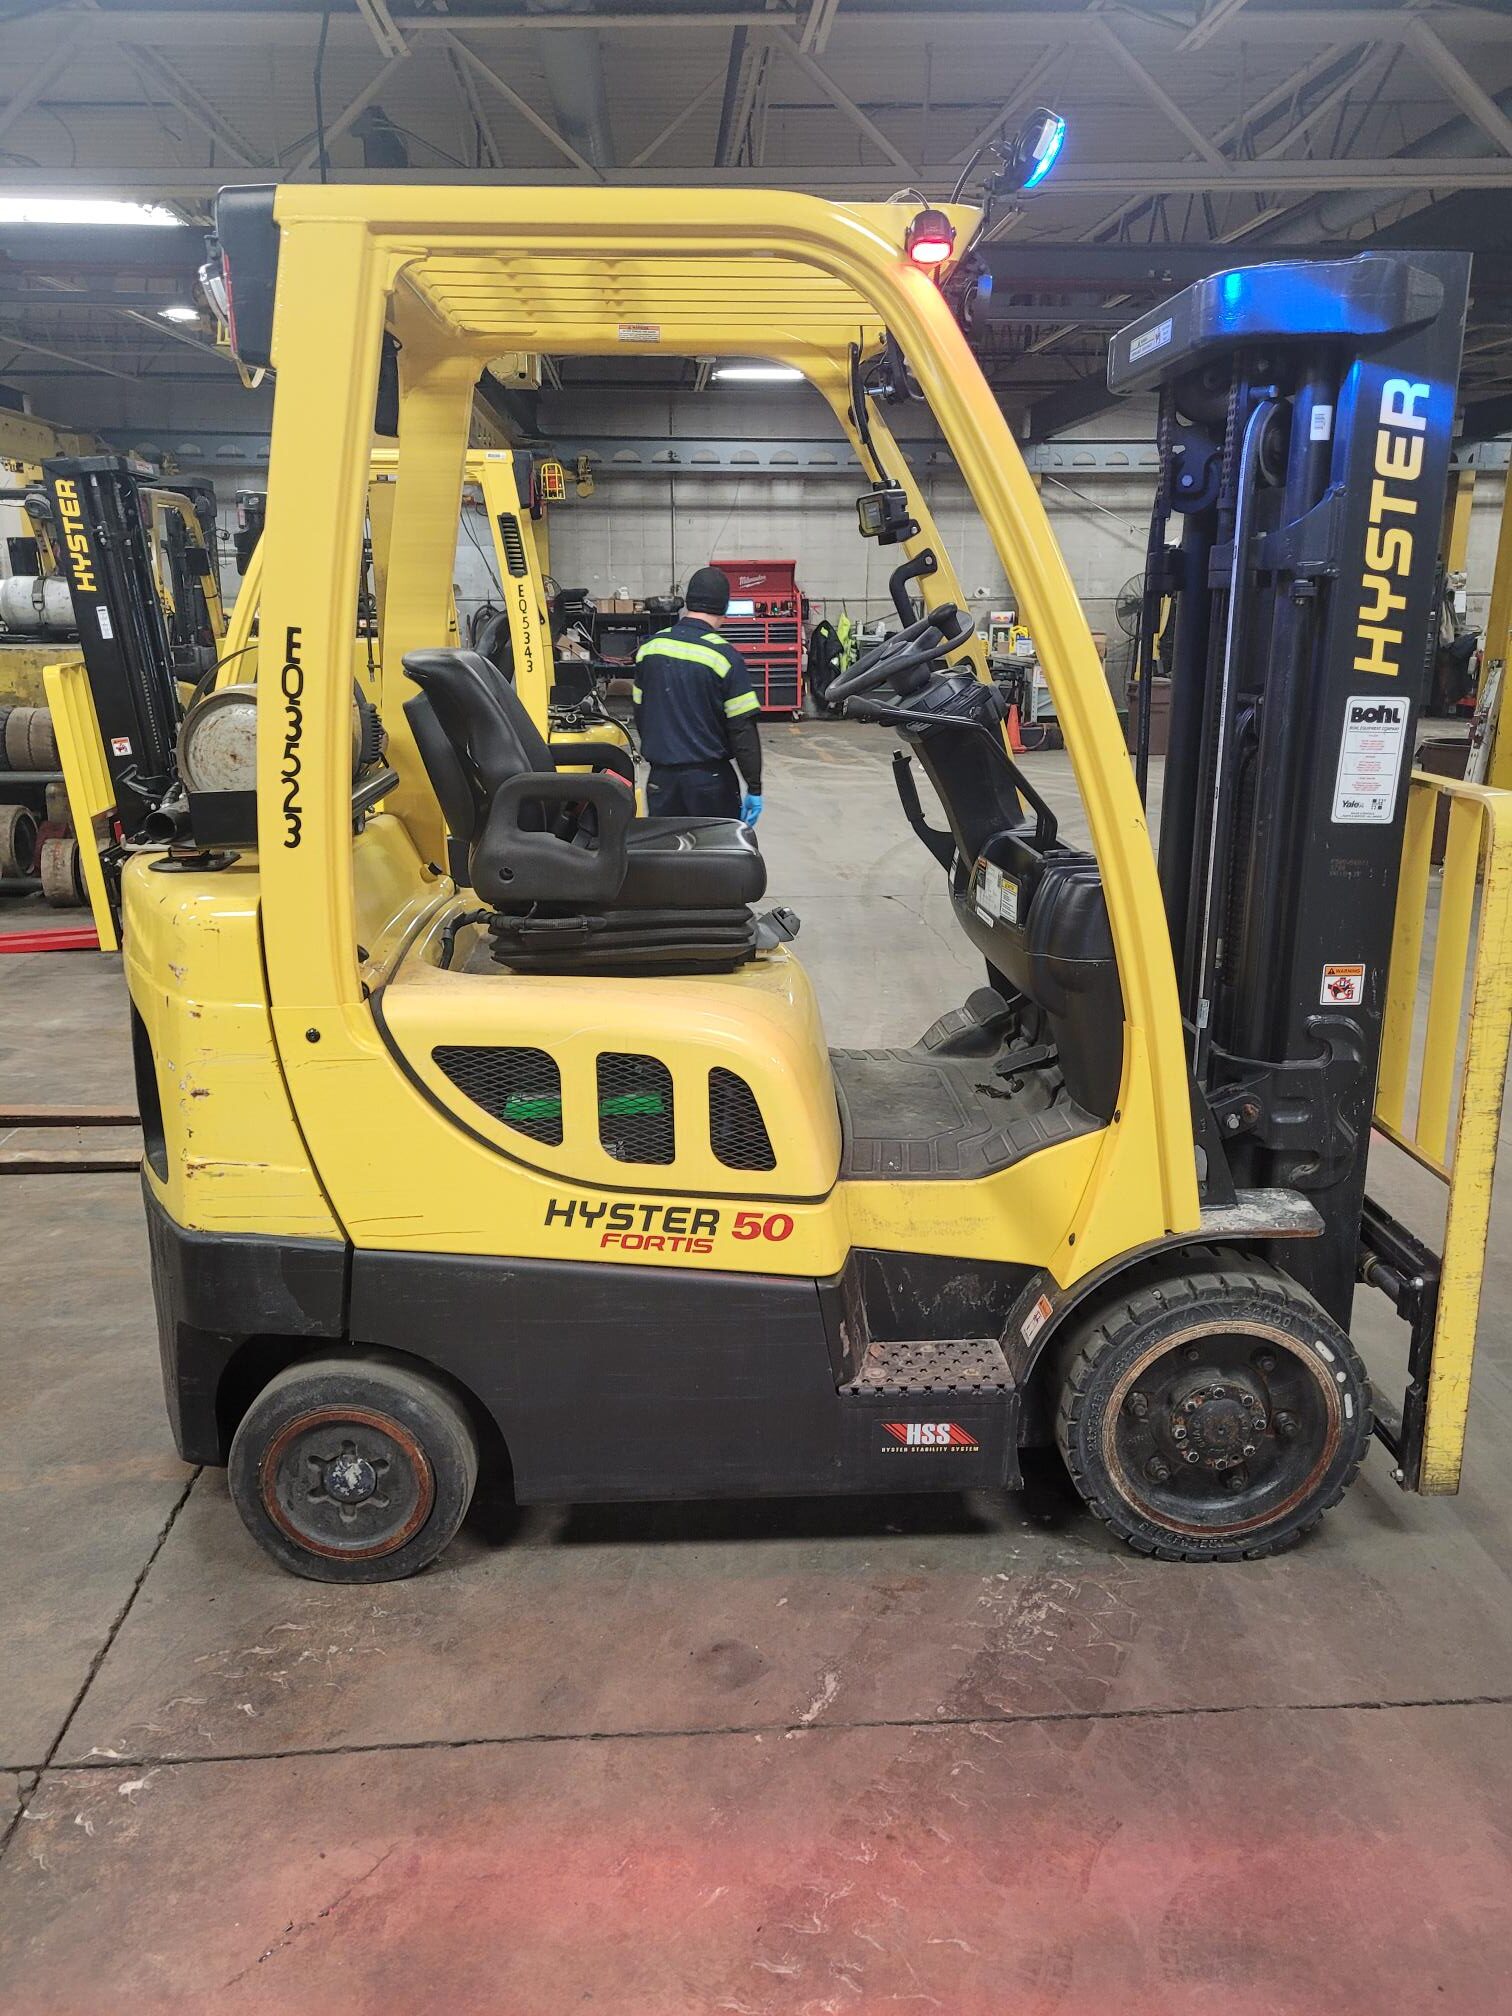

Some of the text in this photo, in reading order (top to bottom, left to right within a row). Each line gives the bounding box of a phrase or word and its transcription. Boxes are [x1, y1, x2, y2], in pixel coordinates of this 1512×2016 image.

[55, 479, 97, 592] HYSTER
[1353, 378, 1430, 677] HYSTER
[518, 584, 533, 673] EQ5343
[281, 626, 304, 849] EQ3523
[1342, 800, 1360, 809] Yale
[544, 1199, 795, 1242] HYSTER 50
[600, 1232, 714, 1254] FORTIS
[906, 1423, 951, 1445] HSS
